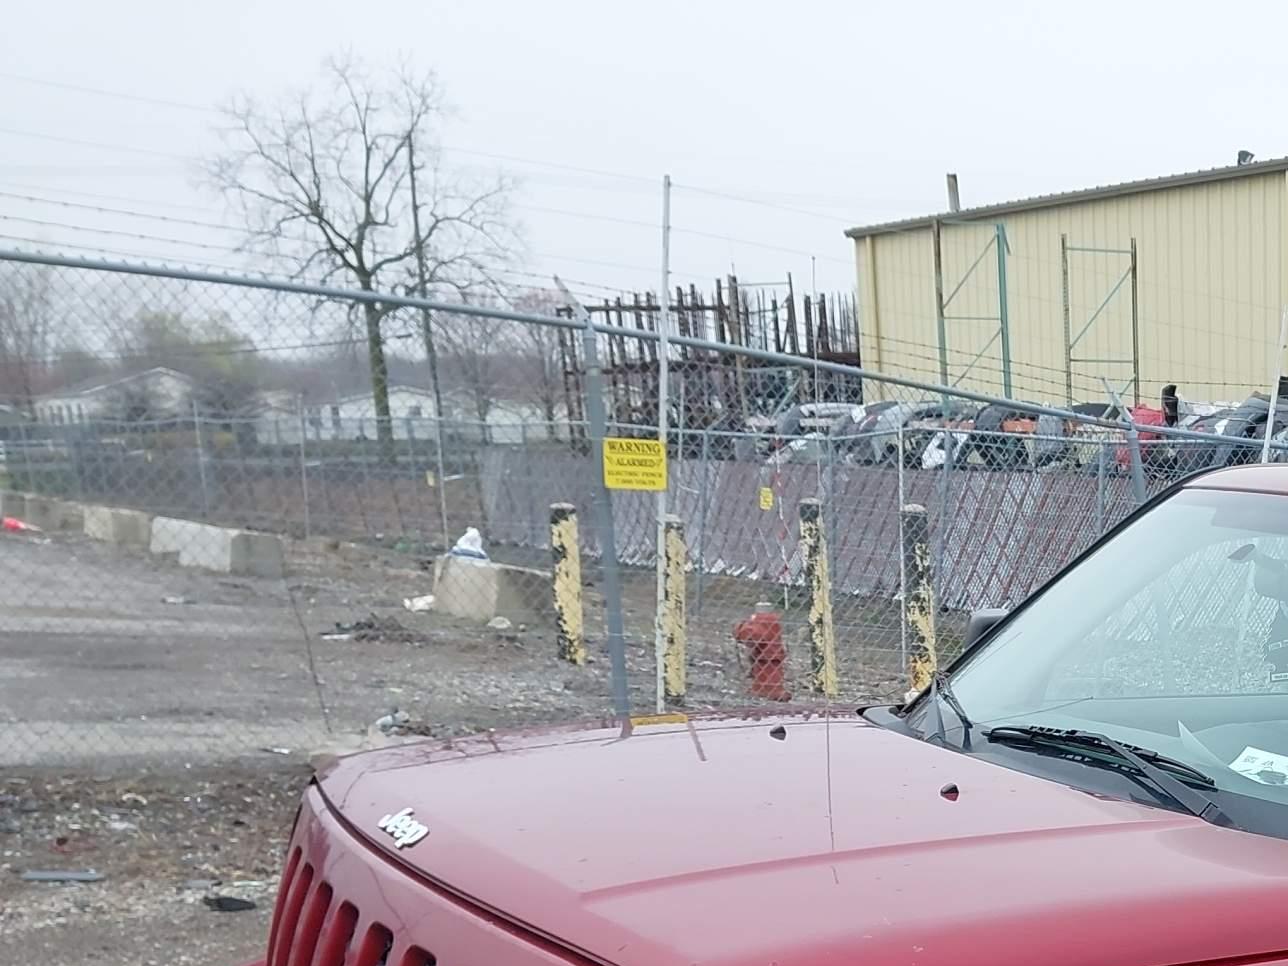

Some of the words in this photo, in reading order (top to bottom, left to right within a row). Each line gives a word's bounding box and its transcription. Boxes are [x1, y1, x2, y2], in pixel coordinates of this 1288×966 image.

[607, 441, 661, 453] WARNING
[616, 457, 656, 468] ALARMED
[378, 807, 429, 849] Jeep
